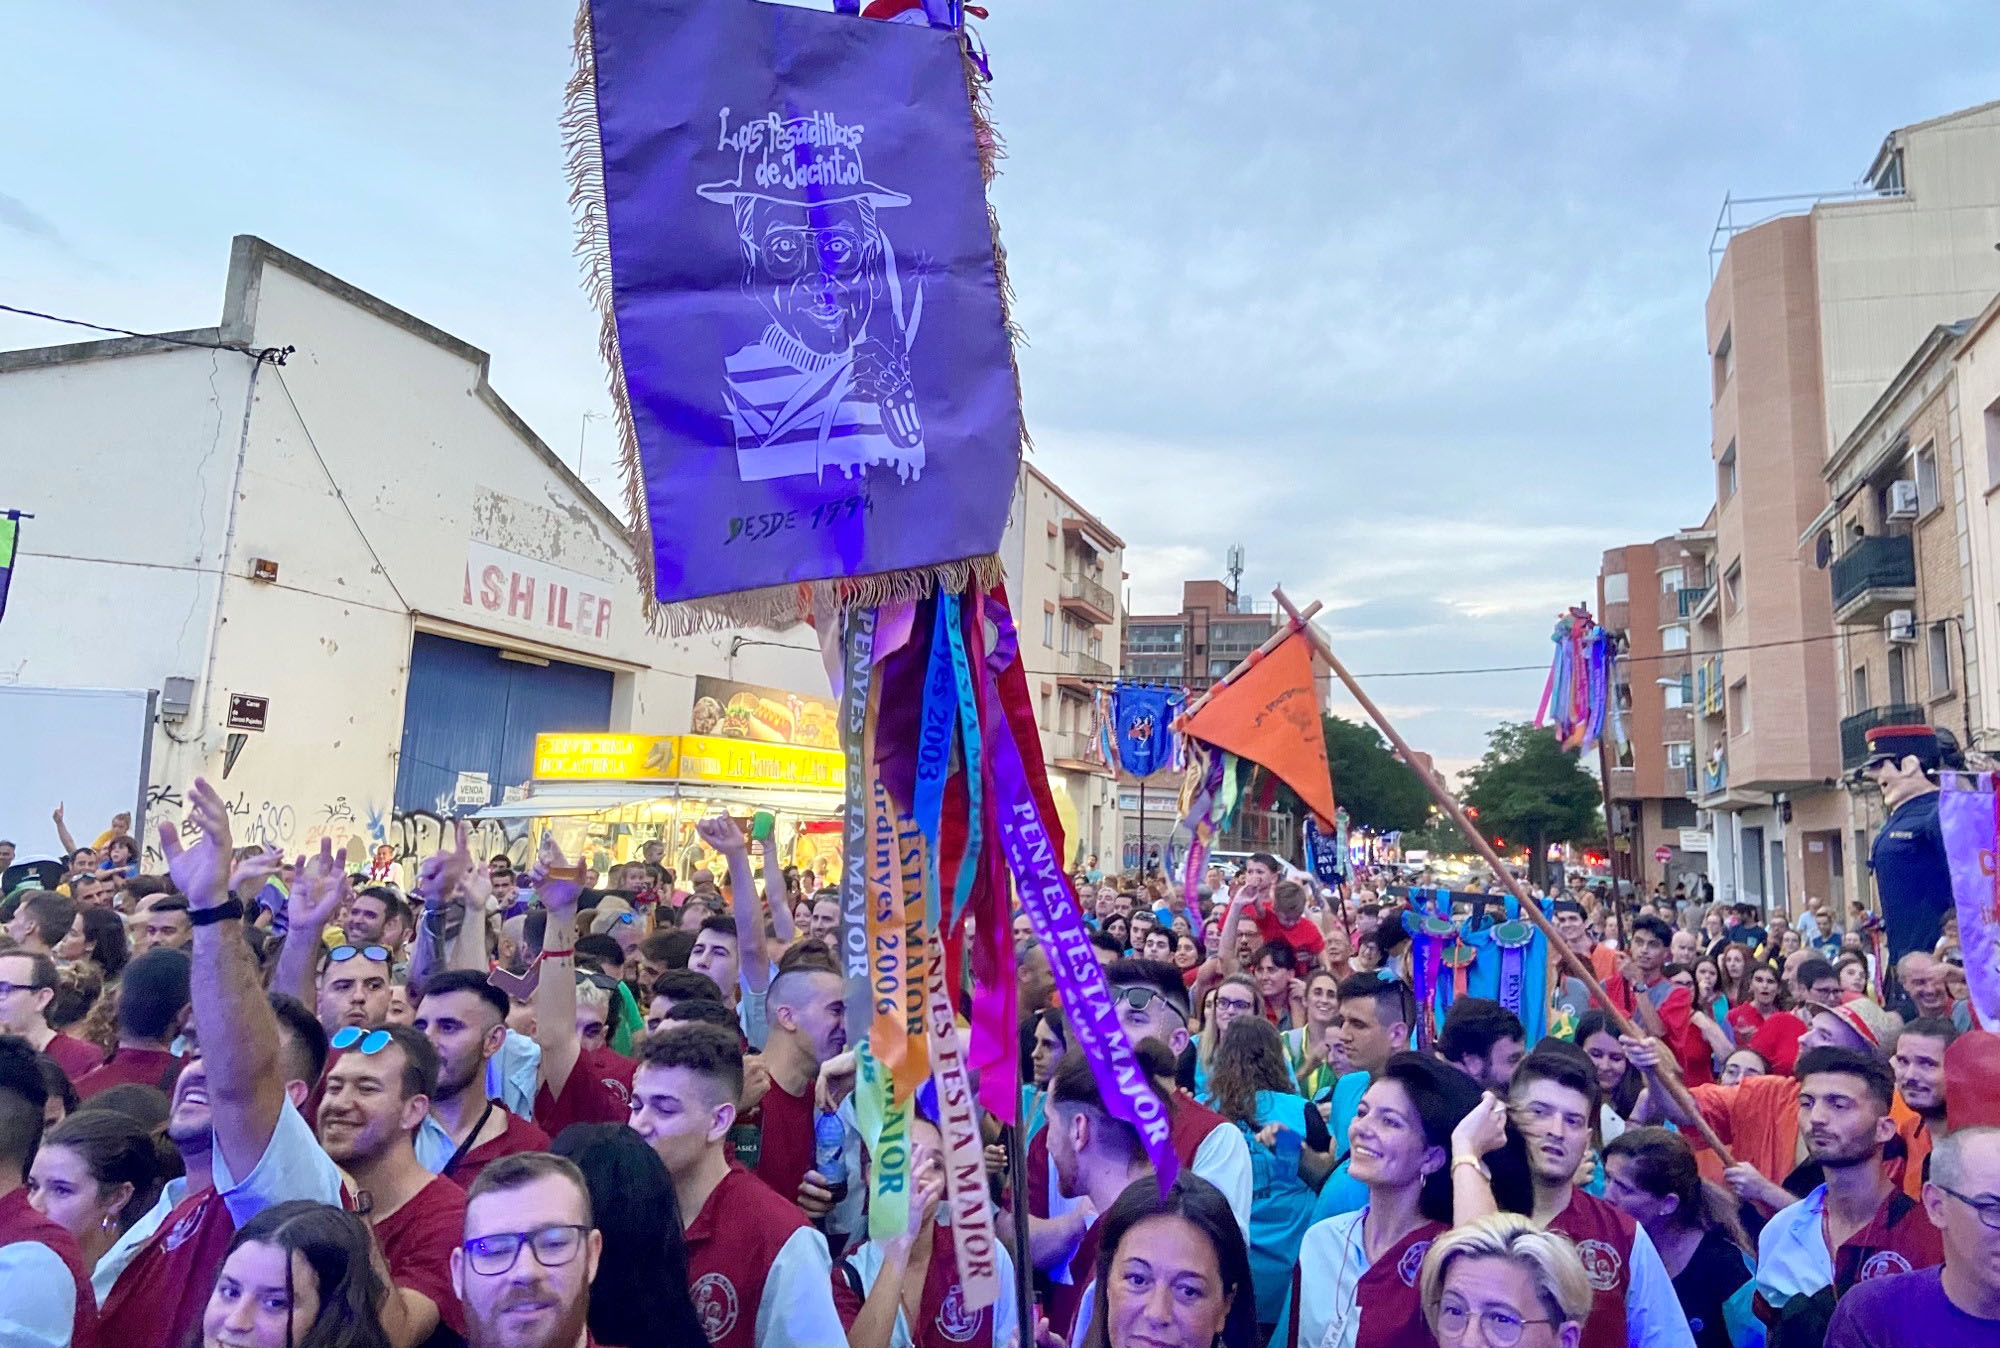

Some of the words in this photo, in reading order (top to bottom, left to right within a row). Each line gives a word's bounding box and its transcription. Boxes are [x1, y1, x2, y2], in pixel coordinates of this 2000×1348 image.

[755, 147, 782, 189] de
[782, 147, 861, 190] Jacinto
[768, 110, 864, 153] Pesadillas
[723, 510, 800, 546] DESDE
[811, 494, 874, 530] 1994
[850, 607, 877, 735] PENYES
[460, 784, 484, 794] VENDA
[917, 706, 949, 782] 2003
[849, 746, 866, 843] FESTA
[870, 778, 894, 923] ardinyes
[844, 855, 869, 979] MAJOR
[875, 934, 899, 1016] 2006
[927, 930, 955, 1039] ENYES
[1013, 800, 1072, 921] PENYES
[1057, 924, 1112, 1023] FESTA
[1104, 1029, 1169, 1147] MAJOR
[1509, 974, 1520, 1015] PENYE
[939, 1050, 974, 1152] FESTA
[954, 1163, 993, 1278] MAJOR
